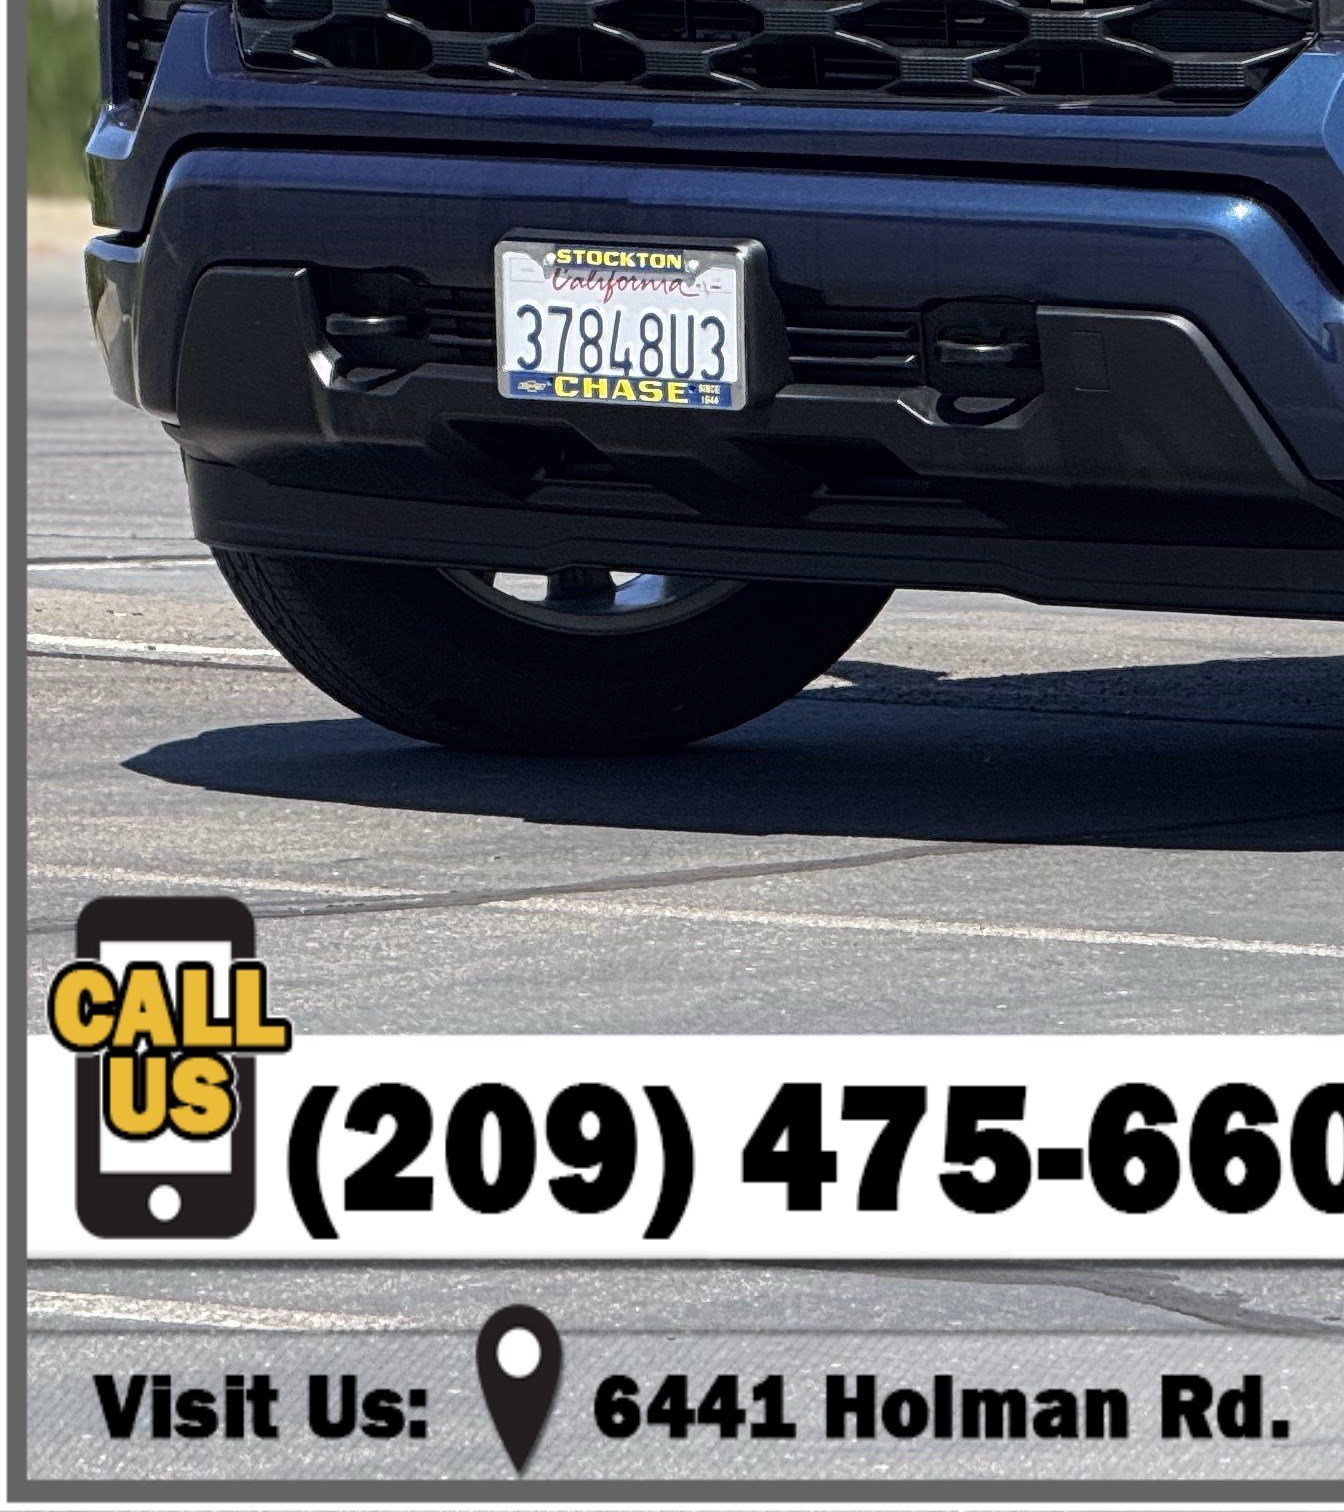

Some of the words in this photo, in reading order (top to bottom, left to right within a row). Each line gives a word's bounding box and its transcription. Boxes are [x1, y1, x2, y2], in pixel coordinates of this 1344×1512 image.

[556, 248, 683, 270] STOCKTON
[552, 268, 699, 303] California
[516, 304, 726, 382] 37848U3
[554, 375, 690, 405] CHASE
